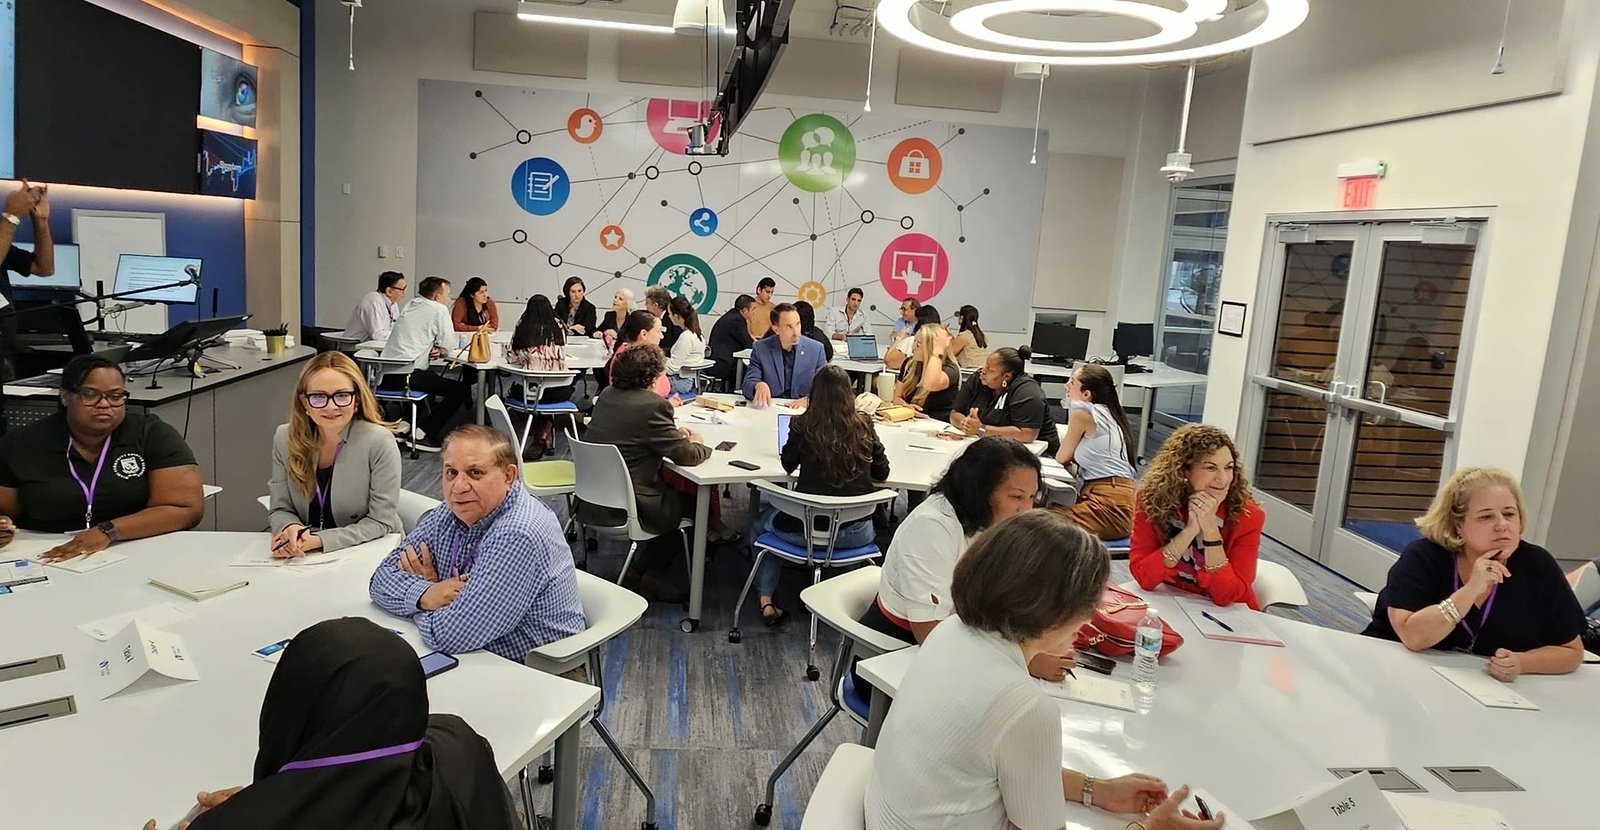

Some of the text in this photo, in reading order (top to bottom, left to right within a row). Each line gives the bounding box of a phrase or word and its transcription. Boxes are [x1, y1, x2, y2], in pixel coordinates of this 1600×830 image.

[1344, 180, 1376, 208] EXIT
[1331, 797, 1356, 816] Table 5
